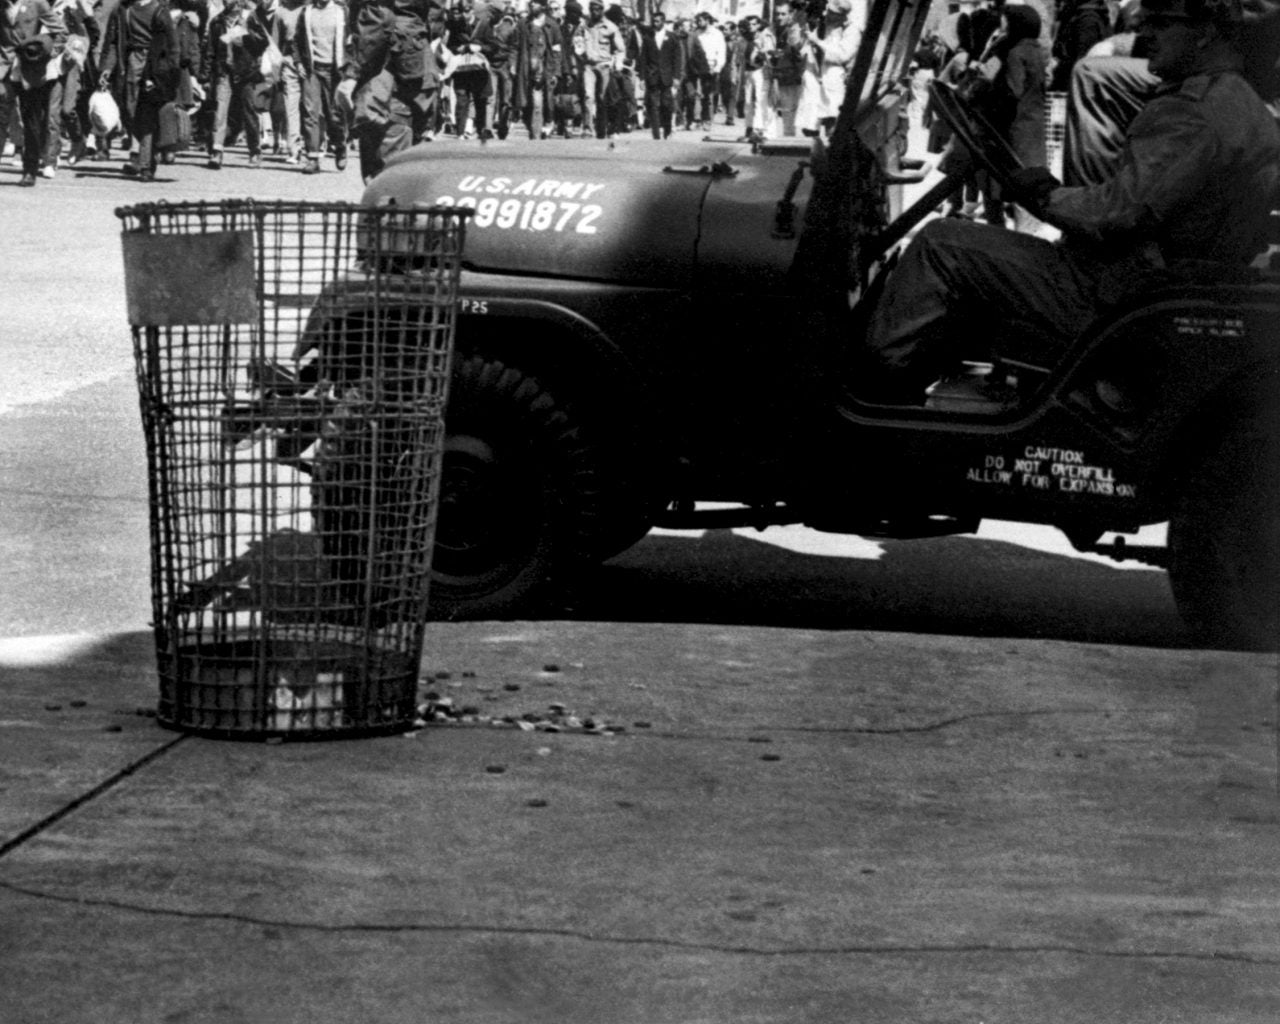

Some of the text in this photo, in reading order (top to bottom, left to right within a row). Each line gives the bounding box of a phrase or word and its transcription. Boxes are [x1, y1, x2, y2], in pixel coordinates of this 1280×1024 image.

[1024, 445, 1084, 464] CAUTION
[966, 467, 1014, 486] ALLOW
[1021, 472, 1050, 490] FOR
[984, 455, 1116, 482] DO NOT OVERFILL
